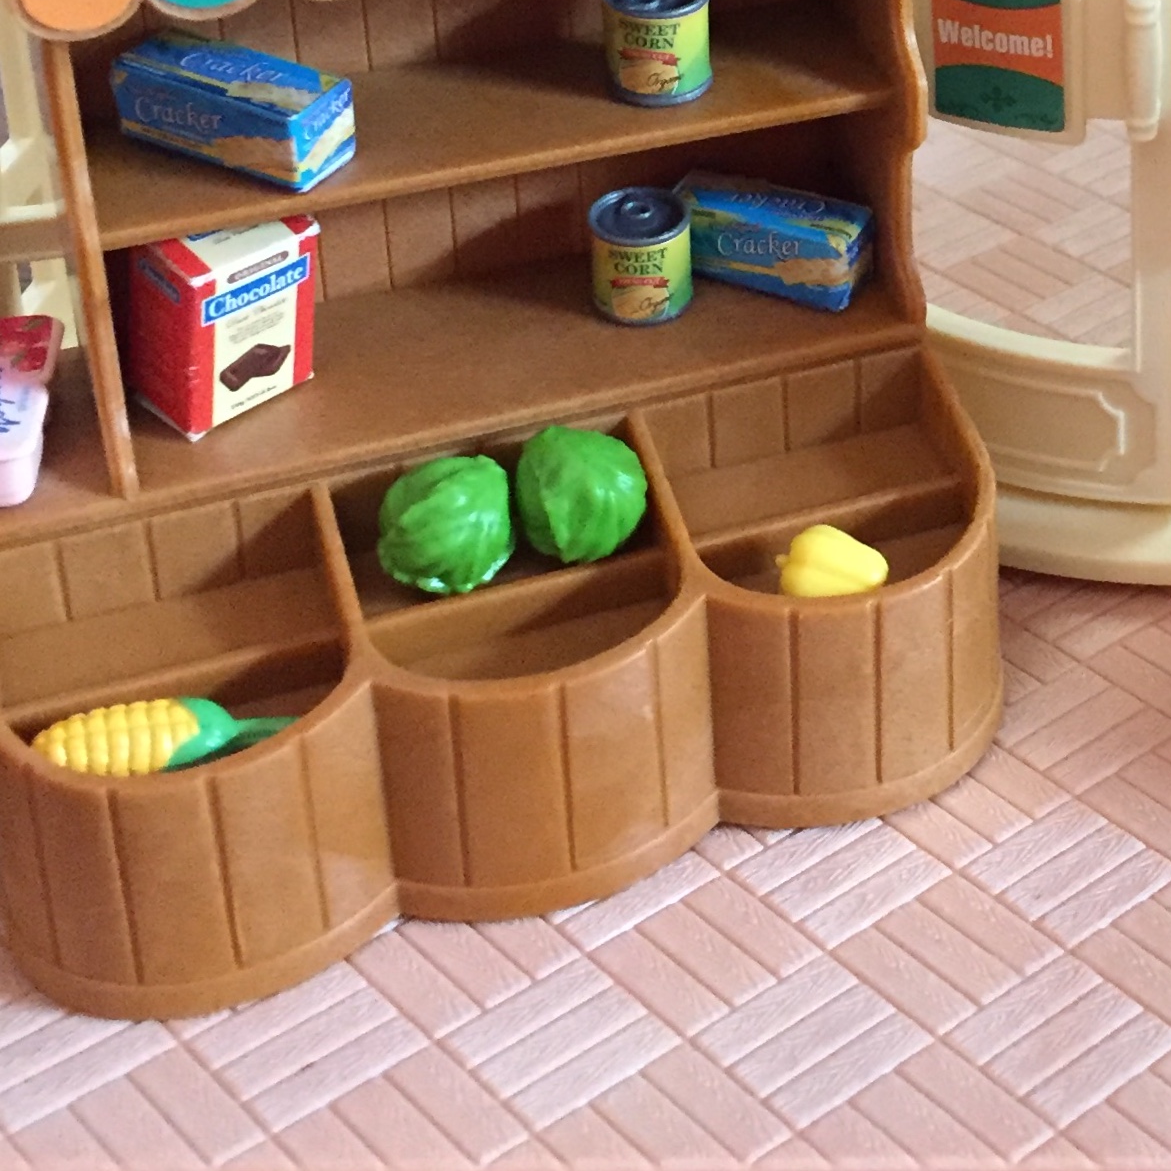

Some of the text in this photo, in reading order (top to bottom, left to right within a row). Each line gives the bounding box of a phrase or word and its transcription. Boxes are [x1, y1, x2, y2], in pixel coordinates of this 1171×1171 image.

[618, 20, 681, 37] SWEET
[936, 18, 1054, 59] Welcome!
[623, 33, 675, 50] CORN
[134, 96, 223, 134] Cracker
[608, 247, 668, 263] SWEET
[716, 230, 803, 260] Cracker
[613, 262, 664, 276] CORN
[207, 264, 304, 318] Chocolate
